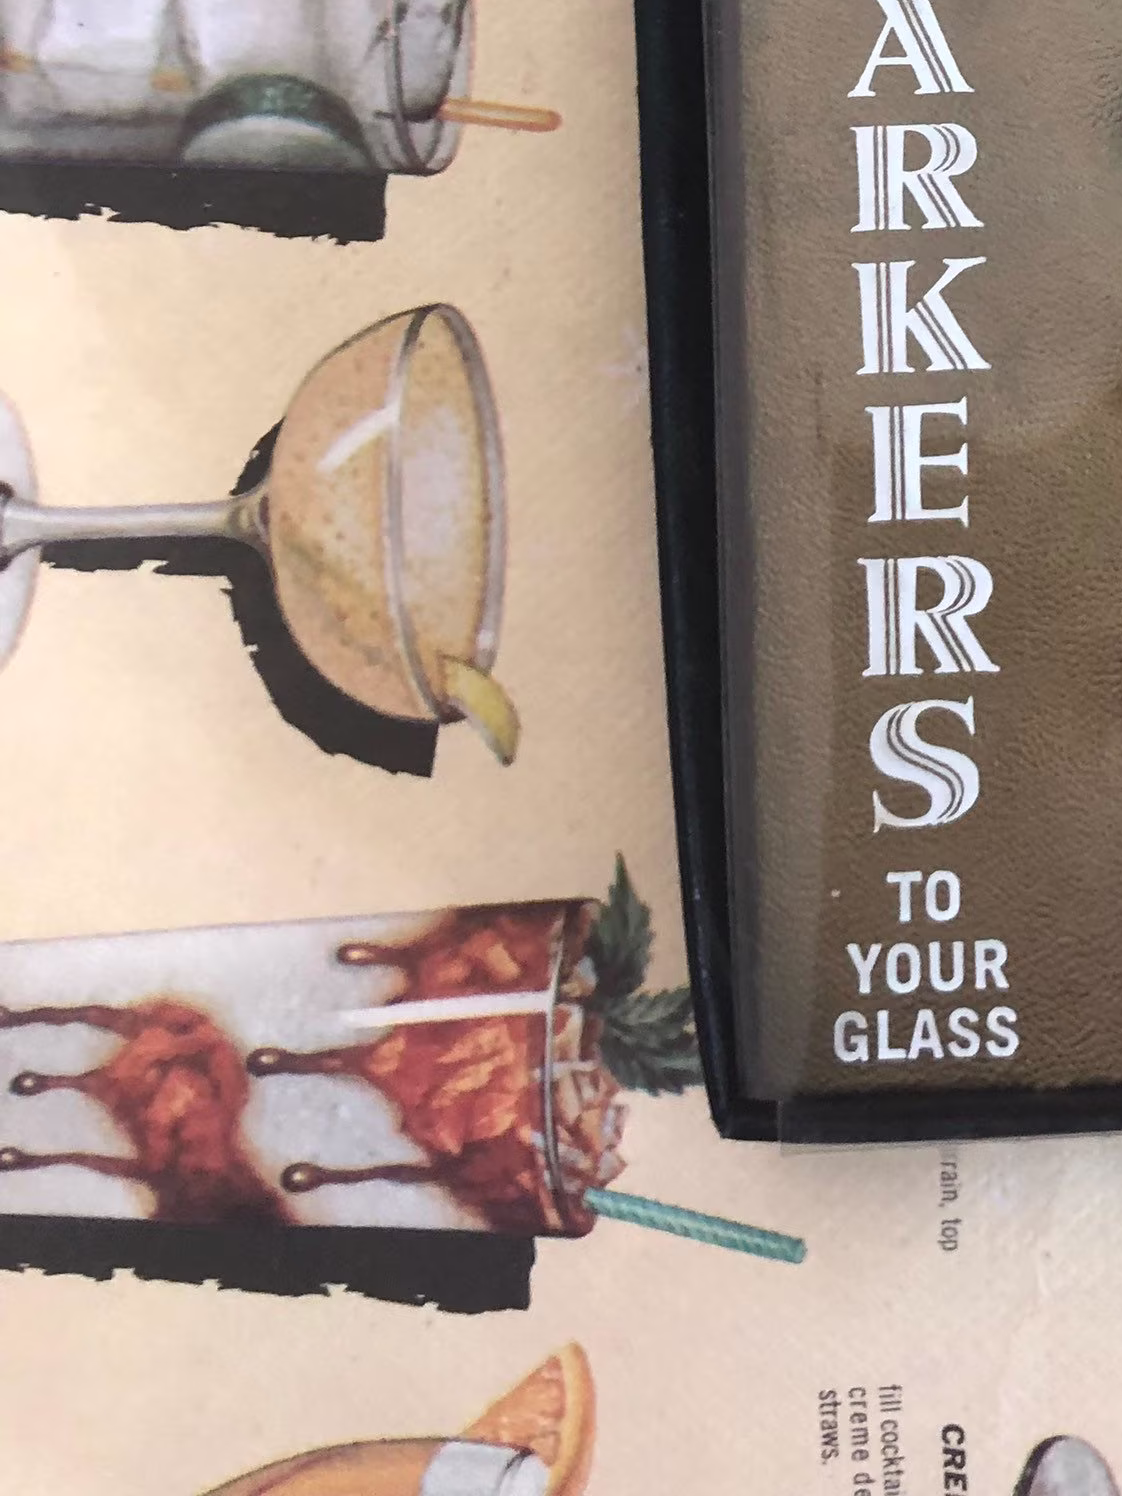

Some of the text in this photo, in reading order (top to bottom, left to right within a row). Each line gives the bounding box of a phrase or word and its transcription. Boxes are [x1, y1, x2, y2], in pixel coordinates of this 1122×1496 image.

[886, 870, 961, 923] TO
[847, 939, 1010, 994] YOUR
[833, 1006, 1020, 1063] GLASS
